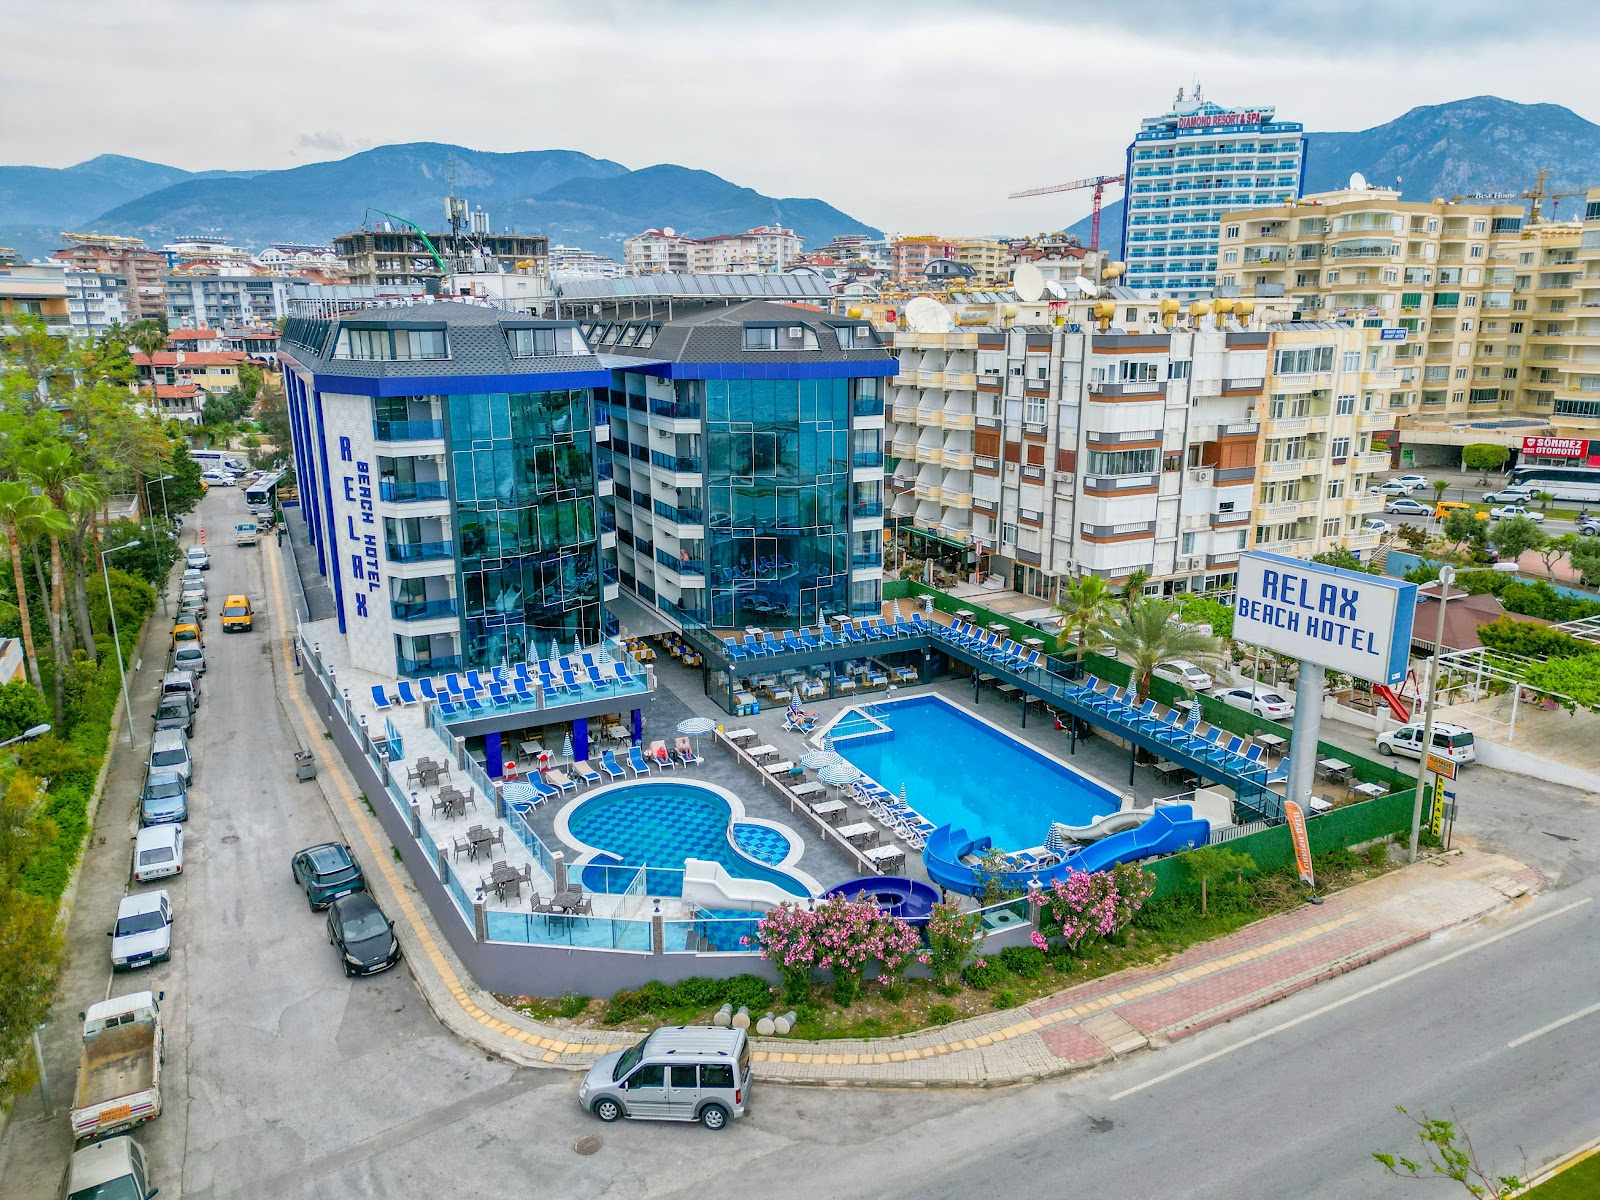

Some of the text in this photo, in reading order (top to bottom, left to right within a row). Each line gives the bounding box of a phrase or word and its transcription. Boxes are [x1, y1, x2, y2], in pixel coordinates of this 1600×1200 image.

[1179, 113, 1260, 127] DIAMOND RESORT & SPA
[1537, 438, 1582, 448] SÖNMEZ
[339, 435, 368, 618] RELAX
[356, 461, 381, 592] BEACH HOTEL
[1262, 569, 1359, 621] RELAX
[1238, 597, 1380, 656] BEACH HOTEL
[1427, 755, 1453, 769] RANGE
[1436, 777, 1445, 804] RENT
